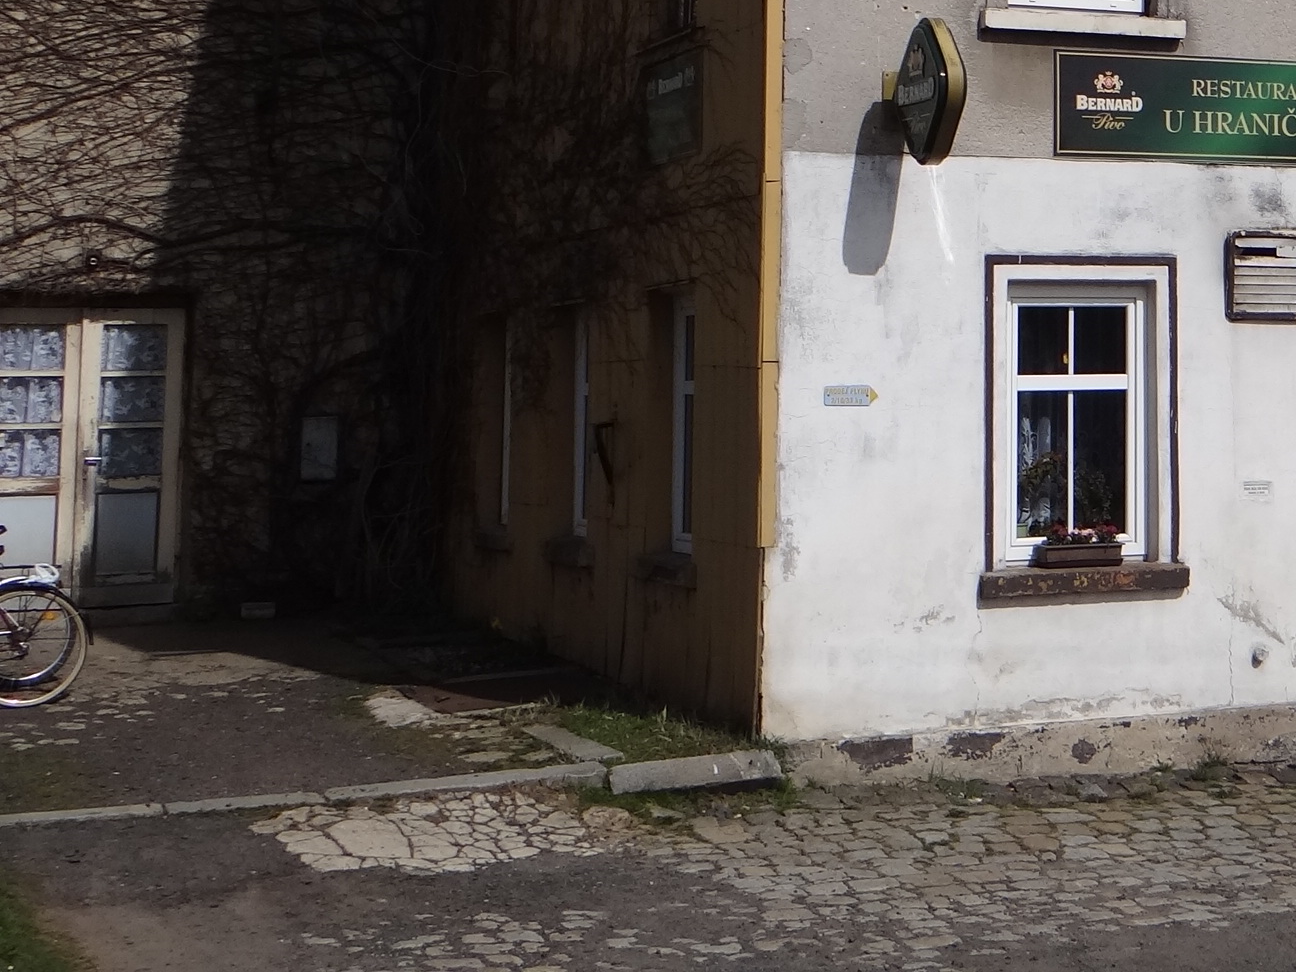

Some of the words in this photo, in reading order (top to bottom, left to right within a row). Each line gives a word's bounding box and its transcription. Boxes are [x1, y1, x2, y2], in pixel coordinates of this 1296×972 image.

[1075, 94, 1144, 113] BERNARD
[1092, 112, 1126, 130] Pivo
[1163, 109, 1186, 133] U
